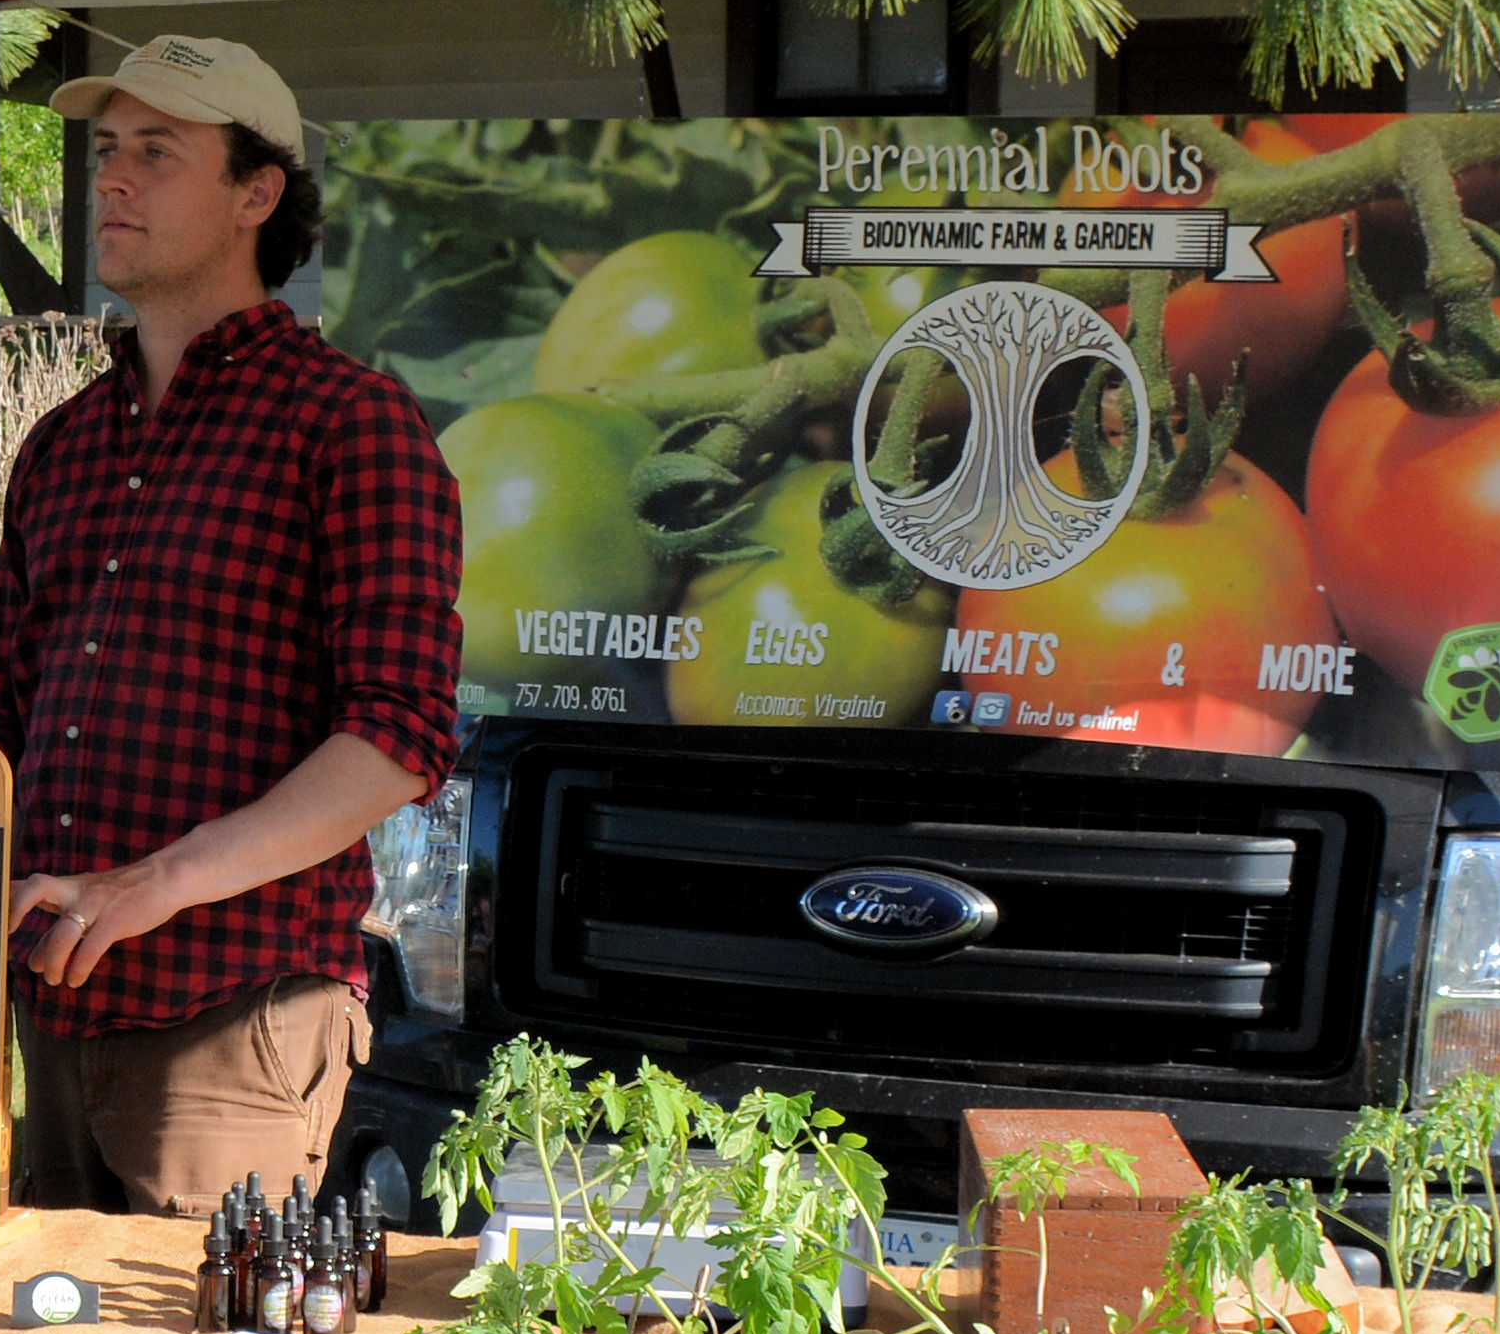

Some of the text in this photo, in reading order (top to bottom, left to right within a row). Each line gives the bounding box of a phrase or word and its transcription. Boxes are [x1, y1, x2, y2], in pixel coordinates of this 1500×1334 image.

[817, 125, 1203, 196] Perennial Roots
[863, 219, 1155, 251] BIODYNAMIC FARM & GARDEN
[514, 609, 1357, 696] VEGETABLES EGGS MEATS & MORE
[515, 682, 627, 712] 757.709.8761
[734, 691, 886, 721] Accomac, Virginia
[1016, 700, 1139, 732] find us online!
[835, 882, 936, 927] Ford
